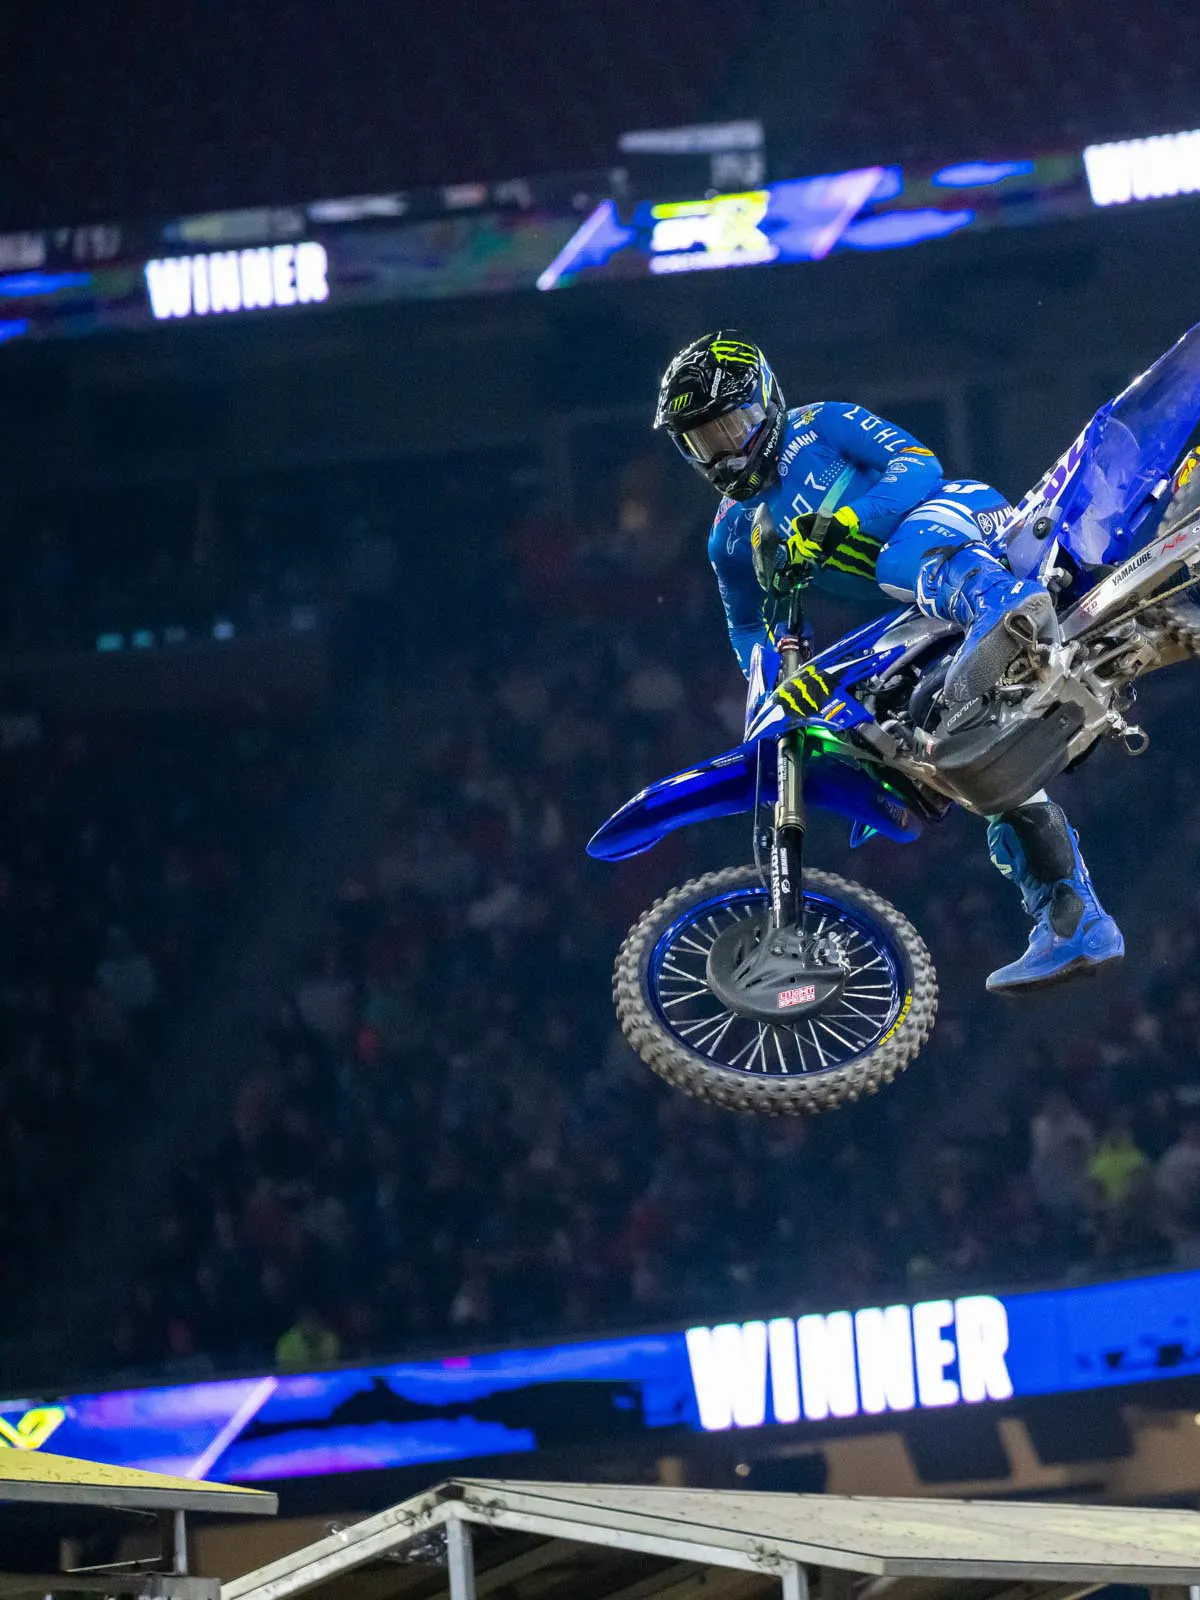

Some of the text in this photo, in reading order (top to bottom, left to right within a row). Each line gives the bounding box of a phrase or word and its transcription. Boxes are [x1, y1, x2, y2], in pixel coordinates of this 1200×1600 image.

[144, 241, 329, 320] WINNER
[782, 430, 819, 465] YAMAHA
[1111, 550, 1153, 587] YAMALUBE
[685, 1294, 1013, 1432] WINNER
